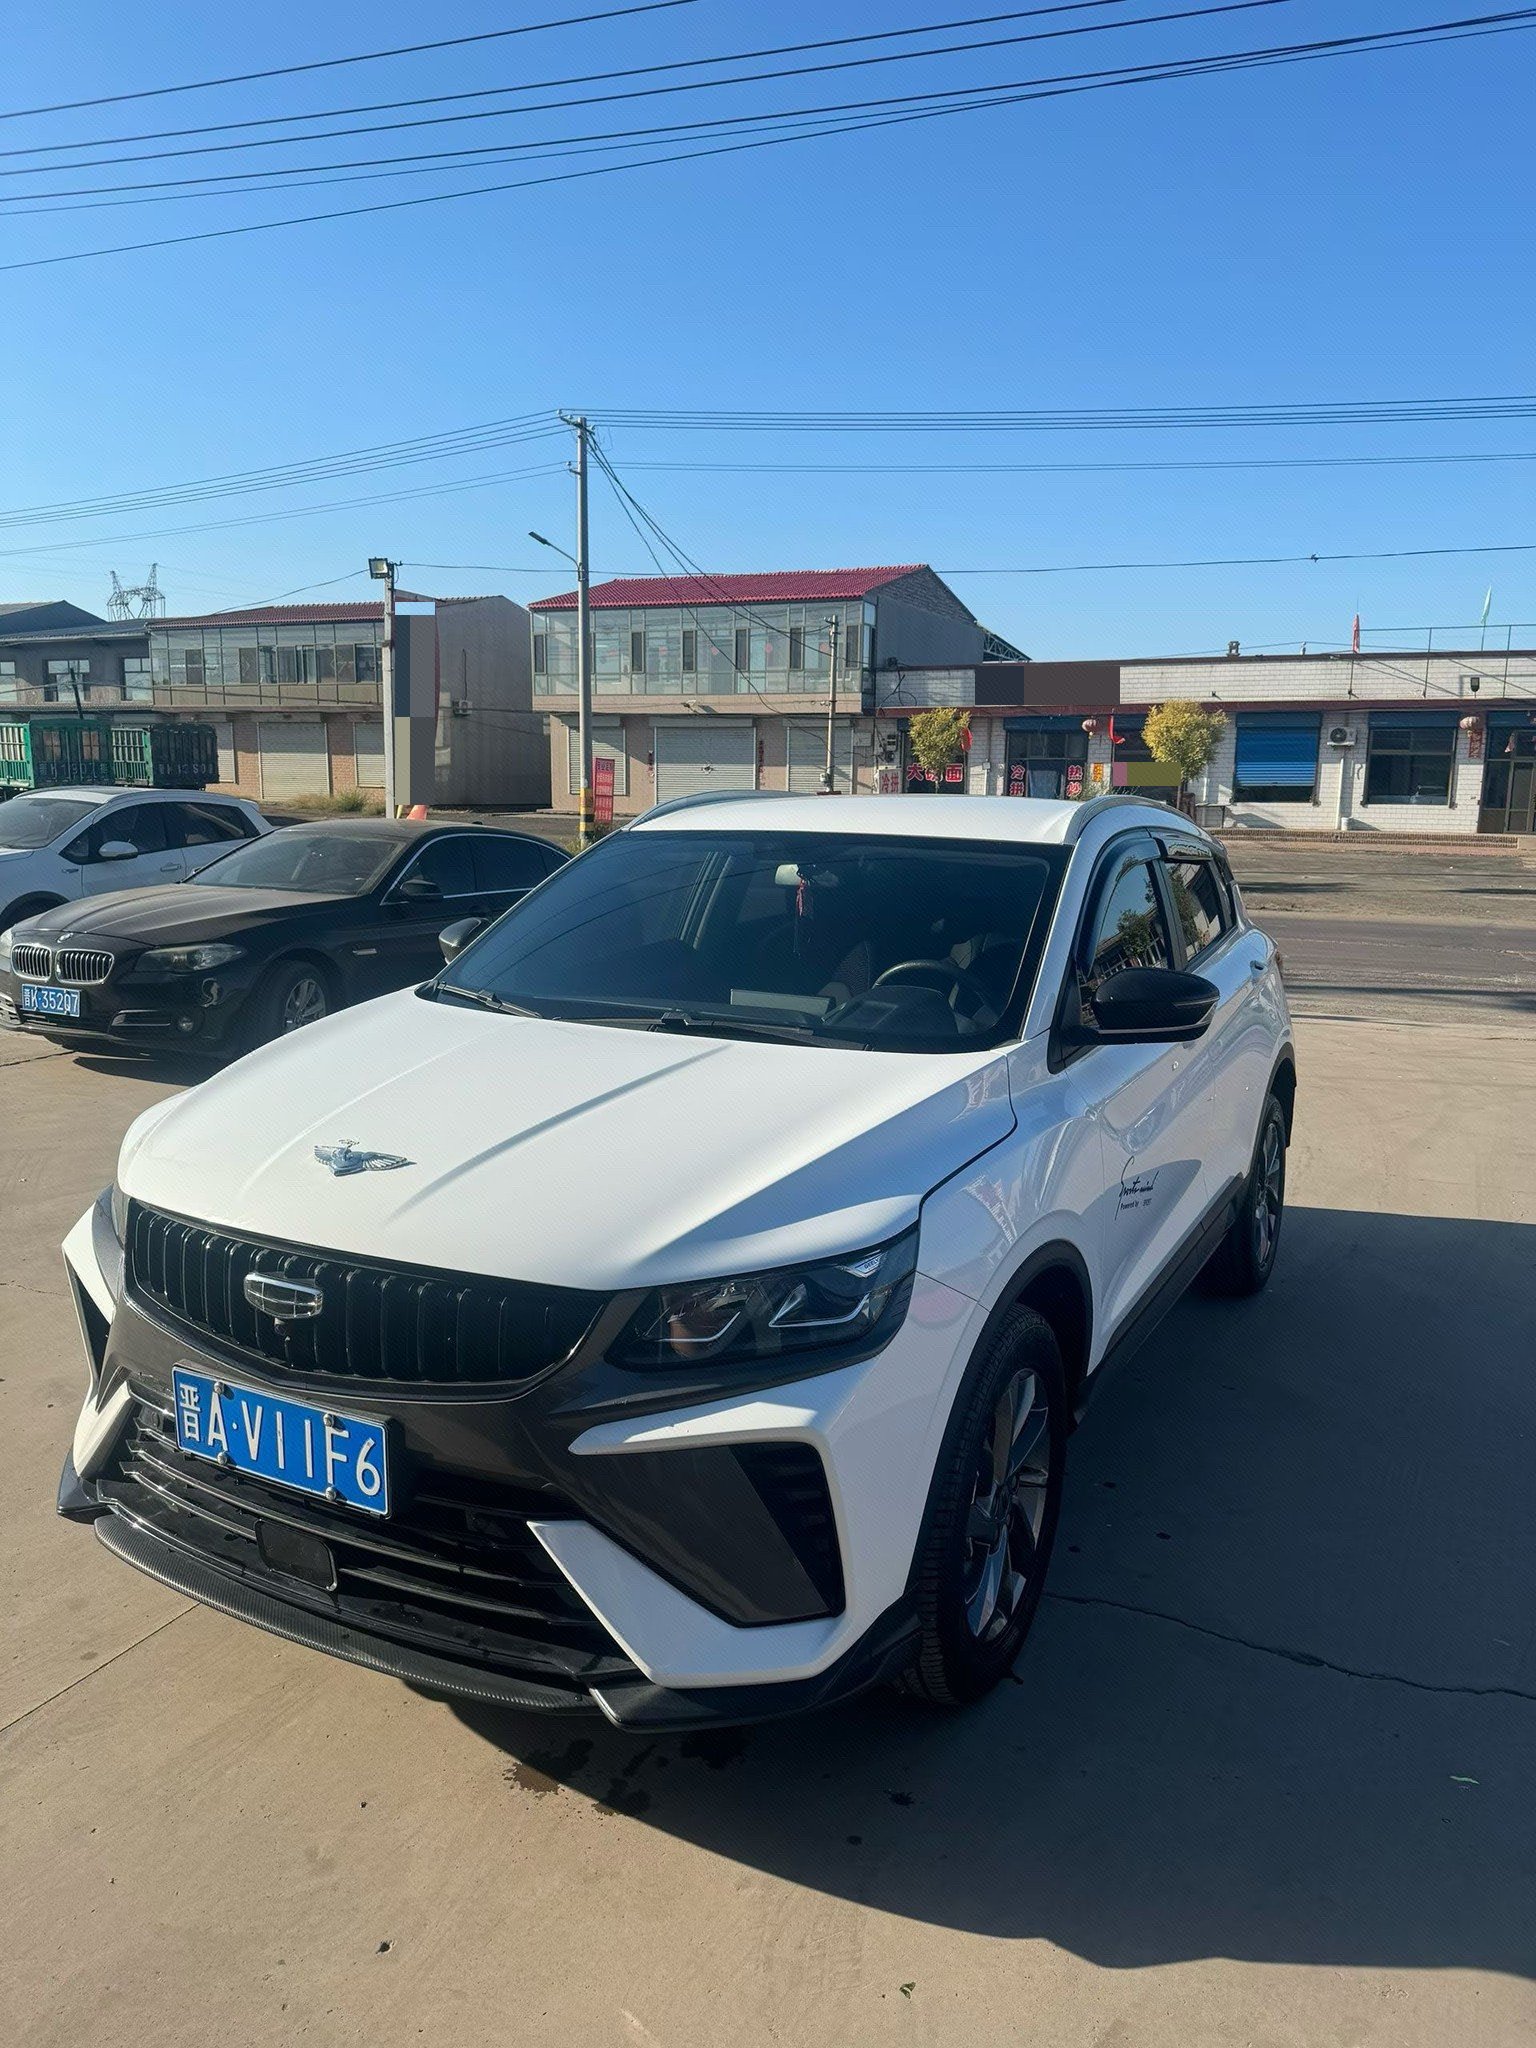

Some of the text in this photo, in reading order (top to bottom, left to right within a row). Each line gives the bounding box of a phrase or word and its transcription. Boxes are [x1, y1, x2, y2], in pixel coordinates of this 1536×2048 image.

[1009, 764, 1026, 797] 冷拼
[1066, 764, 1083, 797] 热炒
[179, 1383, 381, 1497] 晋A·V11F6
